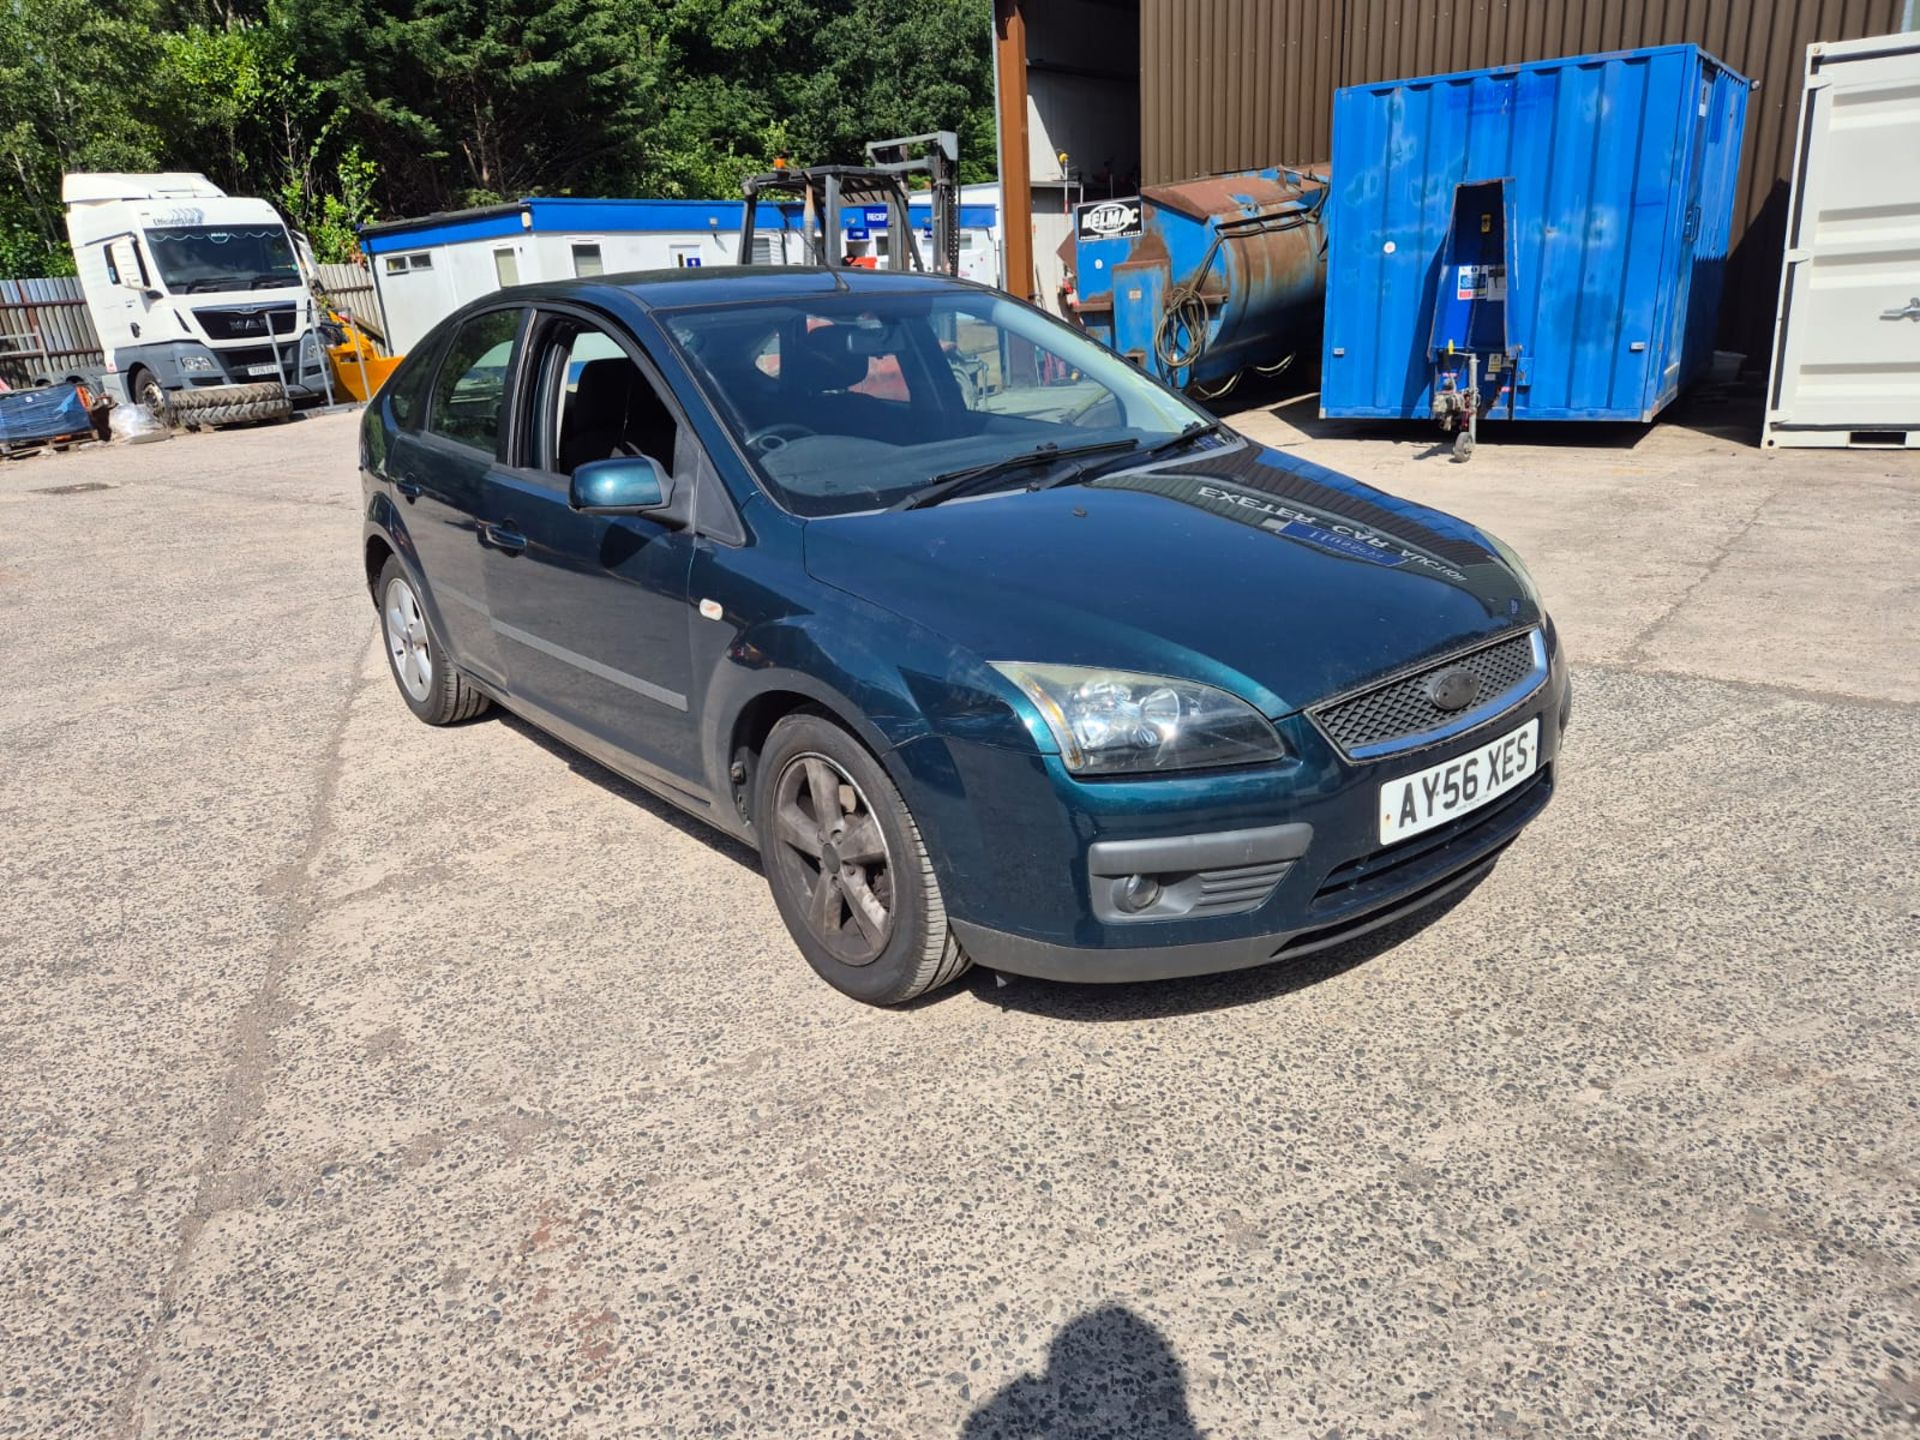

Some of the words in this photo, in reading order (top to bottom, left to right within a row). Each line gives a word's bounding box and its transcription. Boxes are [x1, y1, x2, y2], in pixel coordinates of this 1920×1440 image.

[1082, 207, 1140, 229] BELMAC
[1399, 757, 1479, 828] AY56
[1487, 731, 1529, 791] XES
